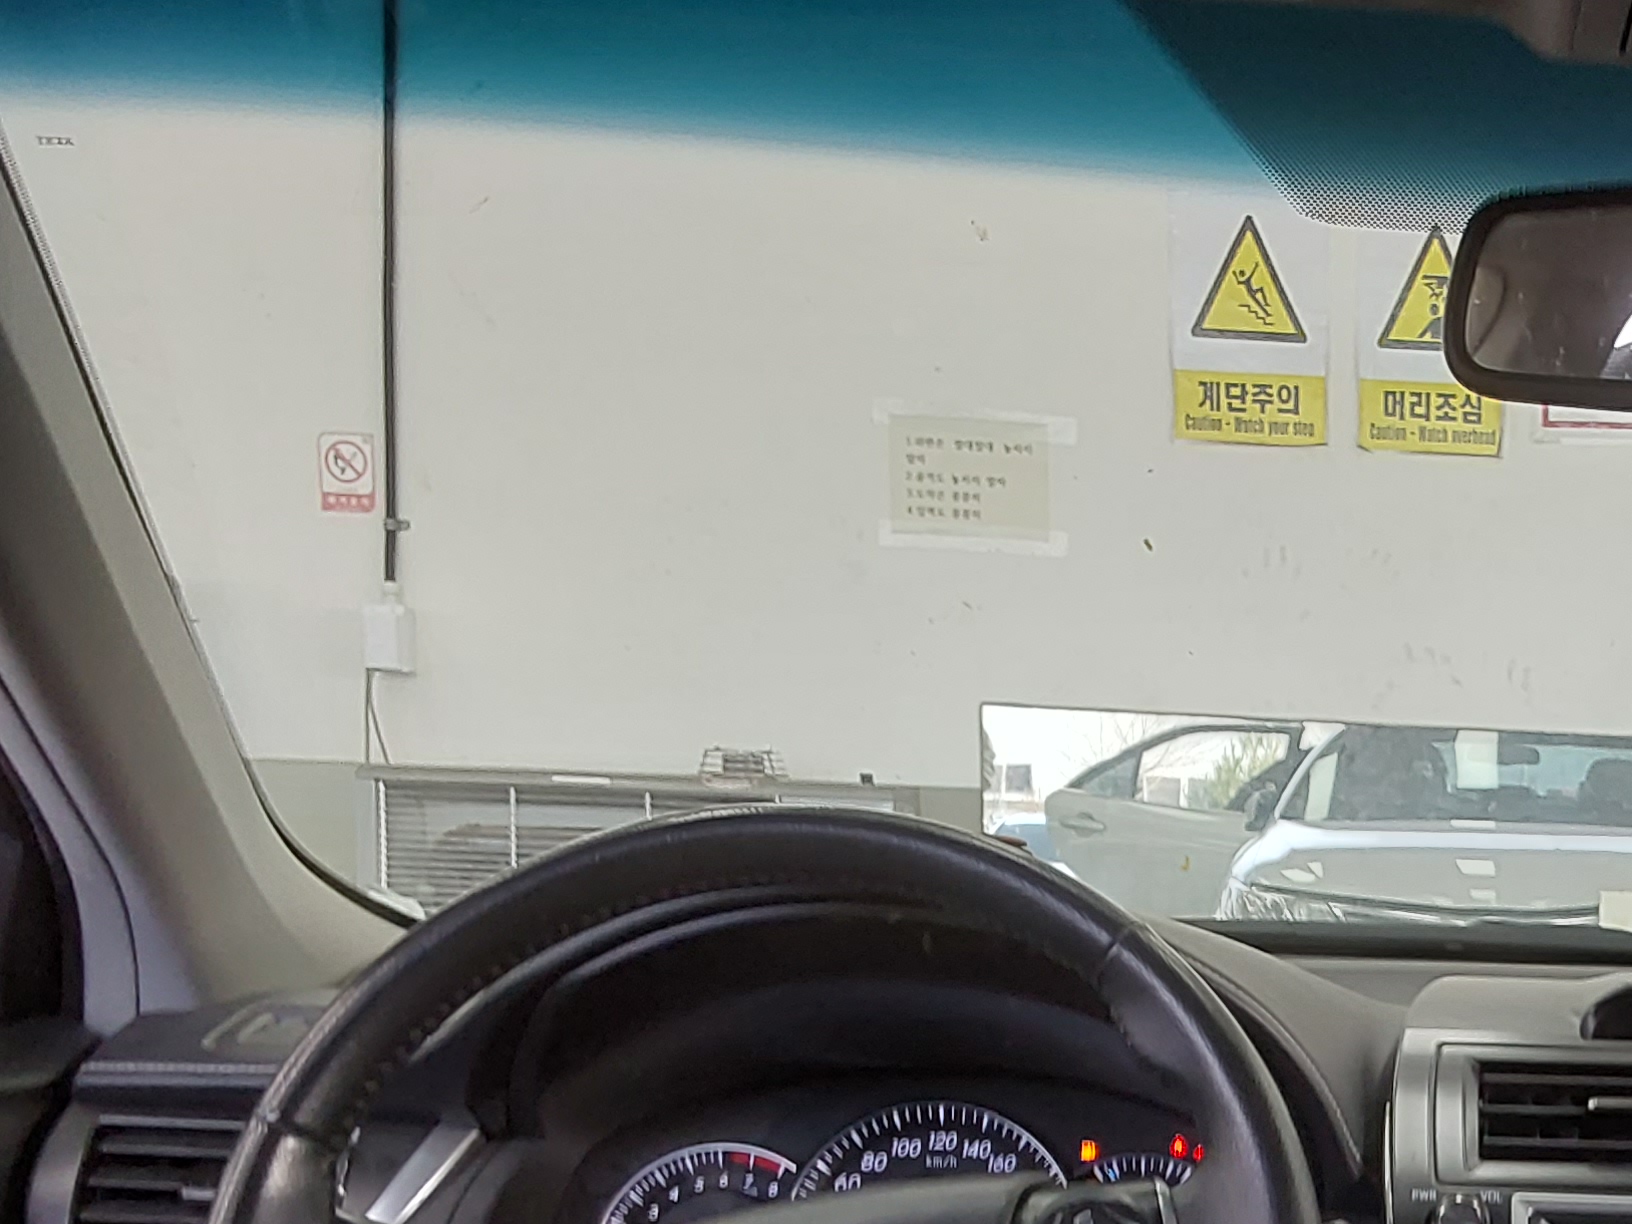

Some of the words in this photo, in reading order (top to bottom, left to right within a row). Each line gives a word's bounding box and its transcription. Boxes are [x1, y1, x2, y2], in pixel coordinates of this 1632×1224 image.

[1198, 381, 1300, 415] 계단주의
[1384, 390, 1482, 424] 머리조심
[892, 1137, 921, 1158] 100
[928, 1130, 958, 1151] 120
[962, 1139, 991, 1160] 140
[861, 1151, 888, 1173] 80
[926, 1154, 958, 1169] km/h
[988, 1153, 1016, 1174] 160
